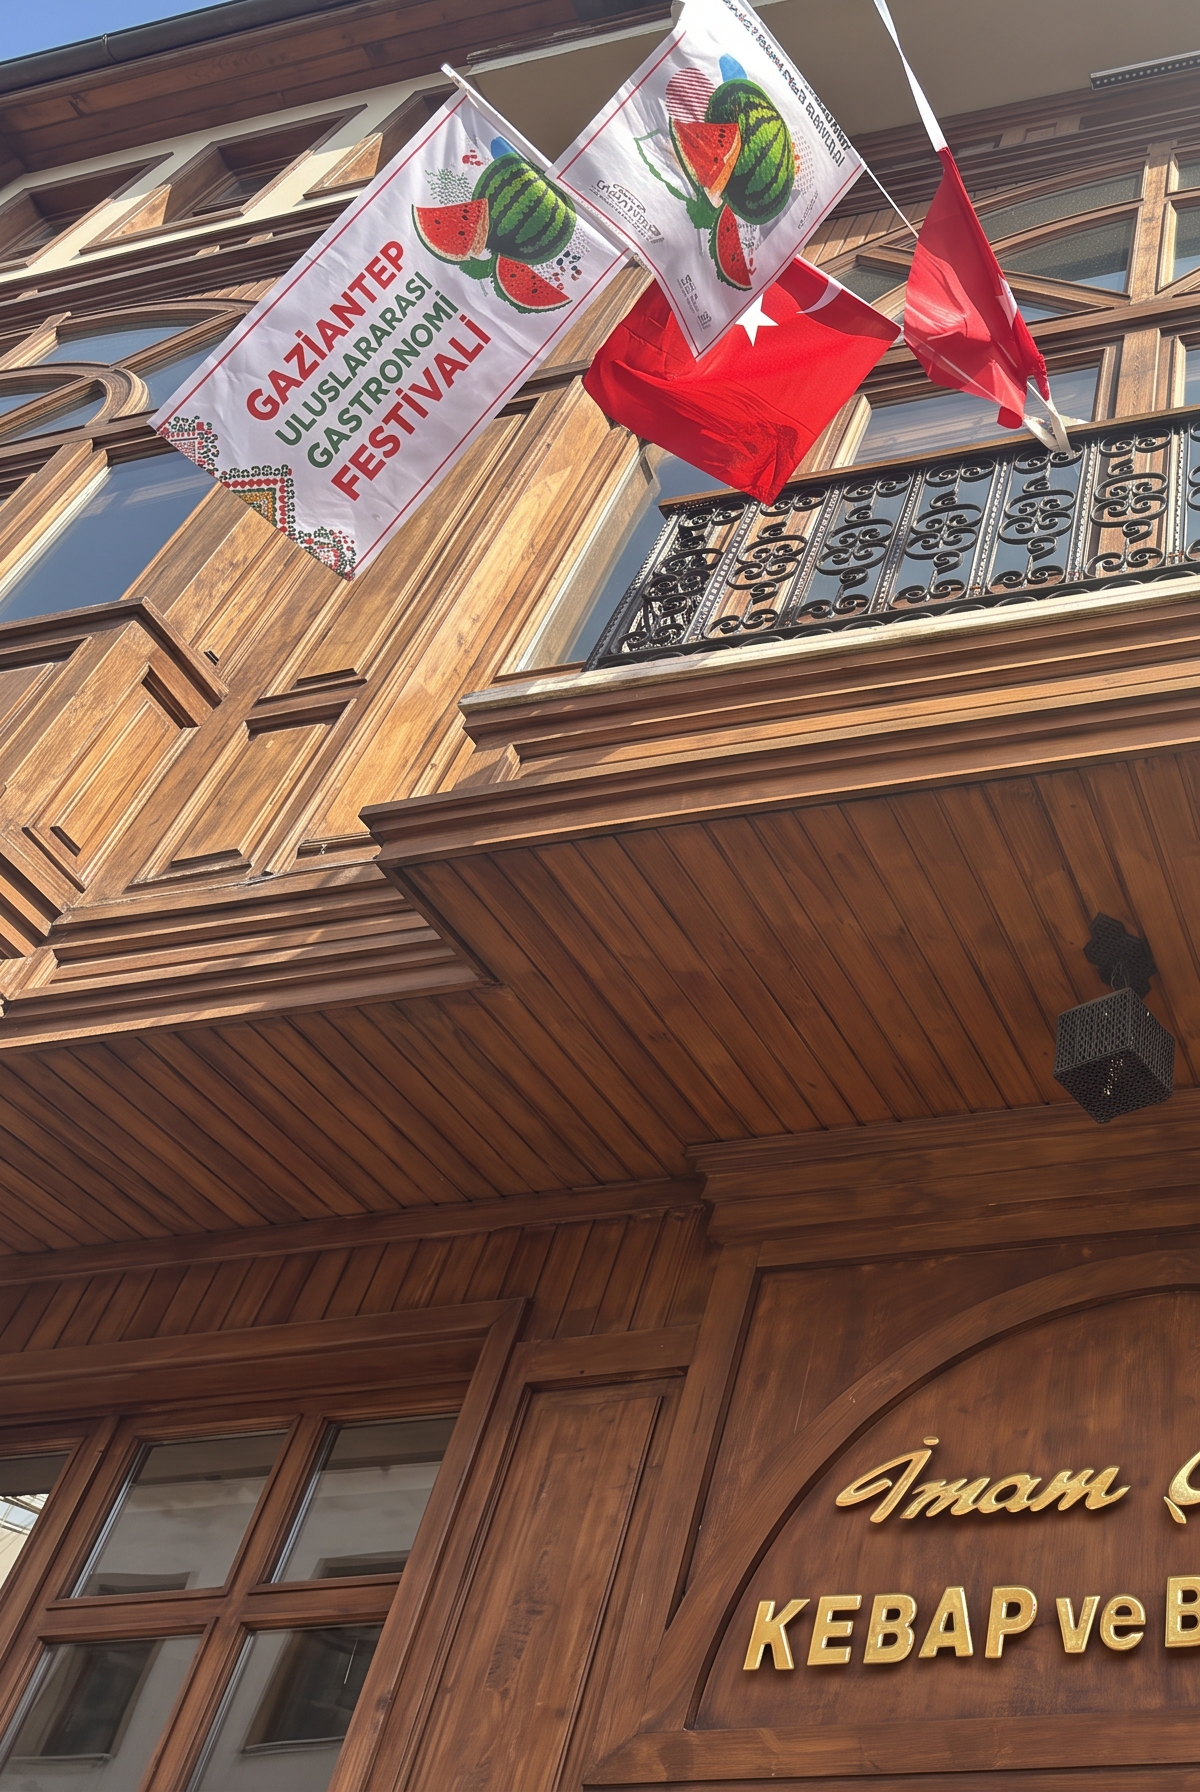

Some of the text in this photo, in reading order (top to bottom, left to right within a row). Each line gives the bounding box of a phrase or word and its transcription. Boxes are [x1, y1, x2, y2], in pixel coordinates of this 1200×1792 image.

[245, 240, 405, 421] GAZİANTEP
[274, 271, 433, 446] ULUSLARARASI
[306, 293, 460, 469] GASTRONOMİ
[330, 315, 492, 501] FESTİVALİ
[835, 1436, 1131, 1524] İmam
[742, 1586, 1038, 1671] KEBAP
[1055, 1595, 1146, 1653] ve
